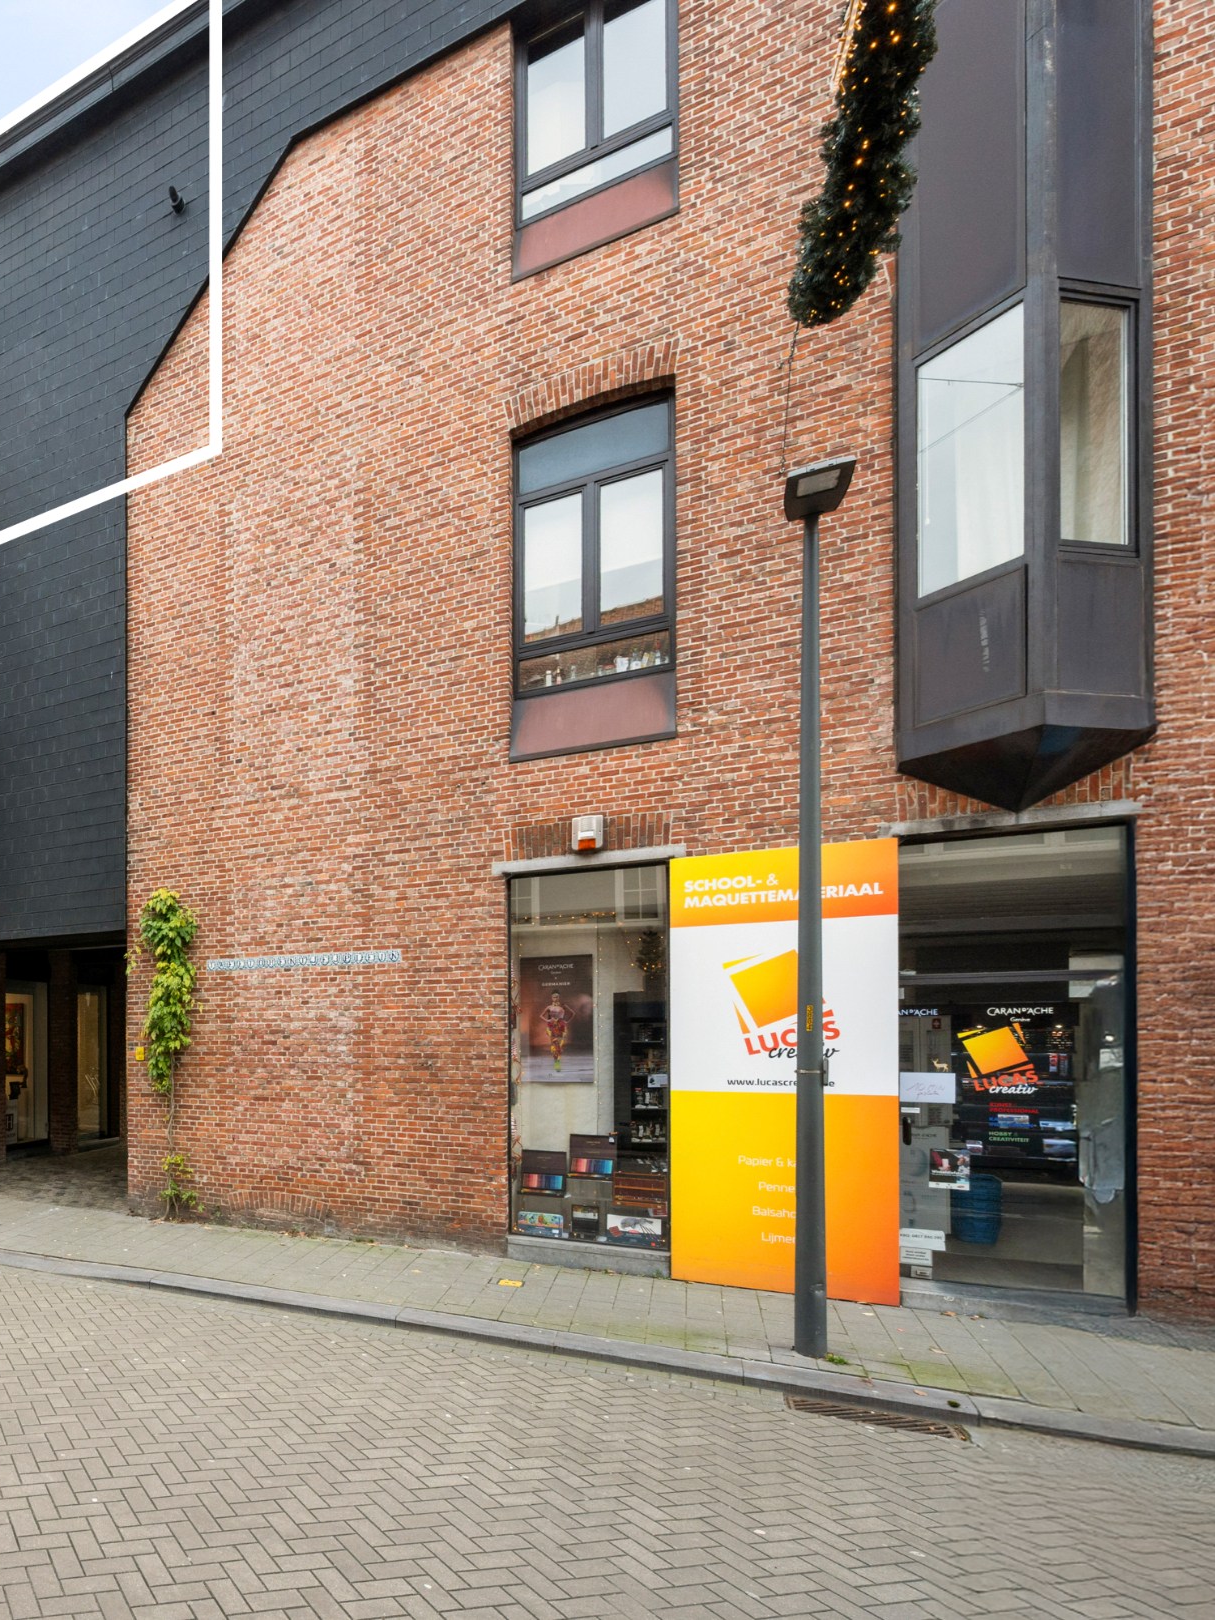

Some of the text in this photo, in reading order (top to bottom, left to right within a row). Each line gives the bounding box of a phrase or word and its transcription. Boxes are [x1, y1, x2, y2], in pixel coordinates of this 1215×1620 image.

[684, 873, 779, 893] SCHOOL- &
[684, 882, 884, 909] MAQUETTEMERIAAL
[743, 1020, 841, 1056] LUCS
[973, 1070, 1039, 1091] LUCAS
[988, 1083, 1039, 1094] creativ
[738, 1155, 773, 1167] Papier
[776, 1157, 784, 1167] &
[758, 1181, 796, 1193] Penne
[752, 1205, 797, 1219] Balsaho
